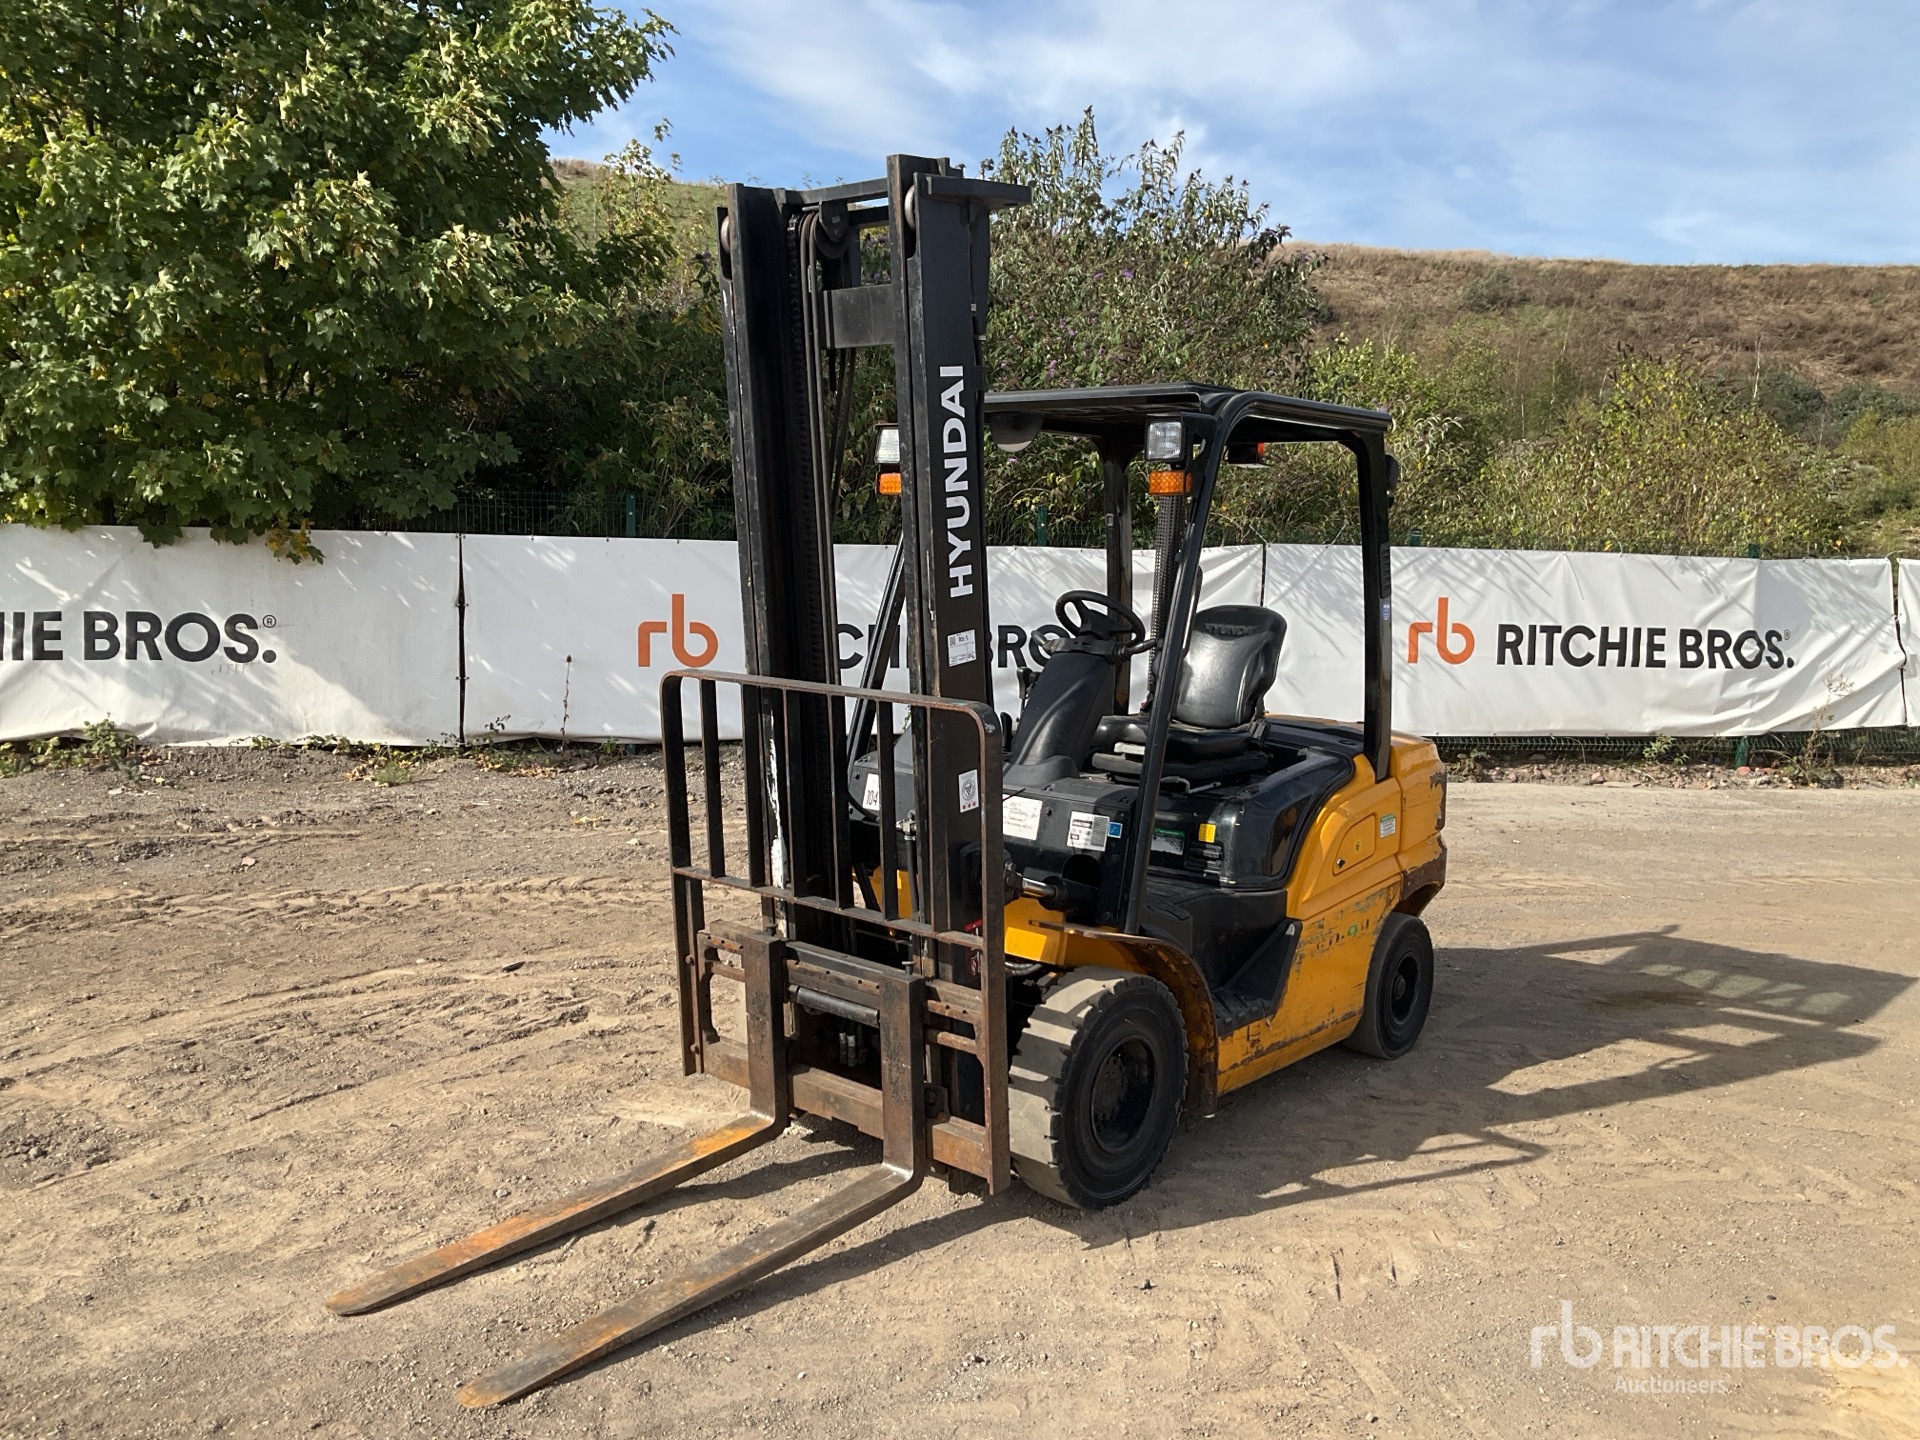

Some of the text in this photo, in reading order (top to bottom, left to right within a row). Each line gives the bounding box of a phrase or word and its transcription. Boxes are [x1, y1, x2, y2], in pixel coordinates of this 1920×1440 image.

[939, 366, 974, 598] HYUNDAI
[637, 593, 719, 669] rb
[1407, 597, 1475, 665] rb
[1496, 623, 1667, 669] RITCHIE
